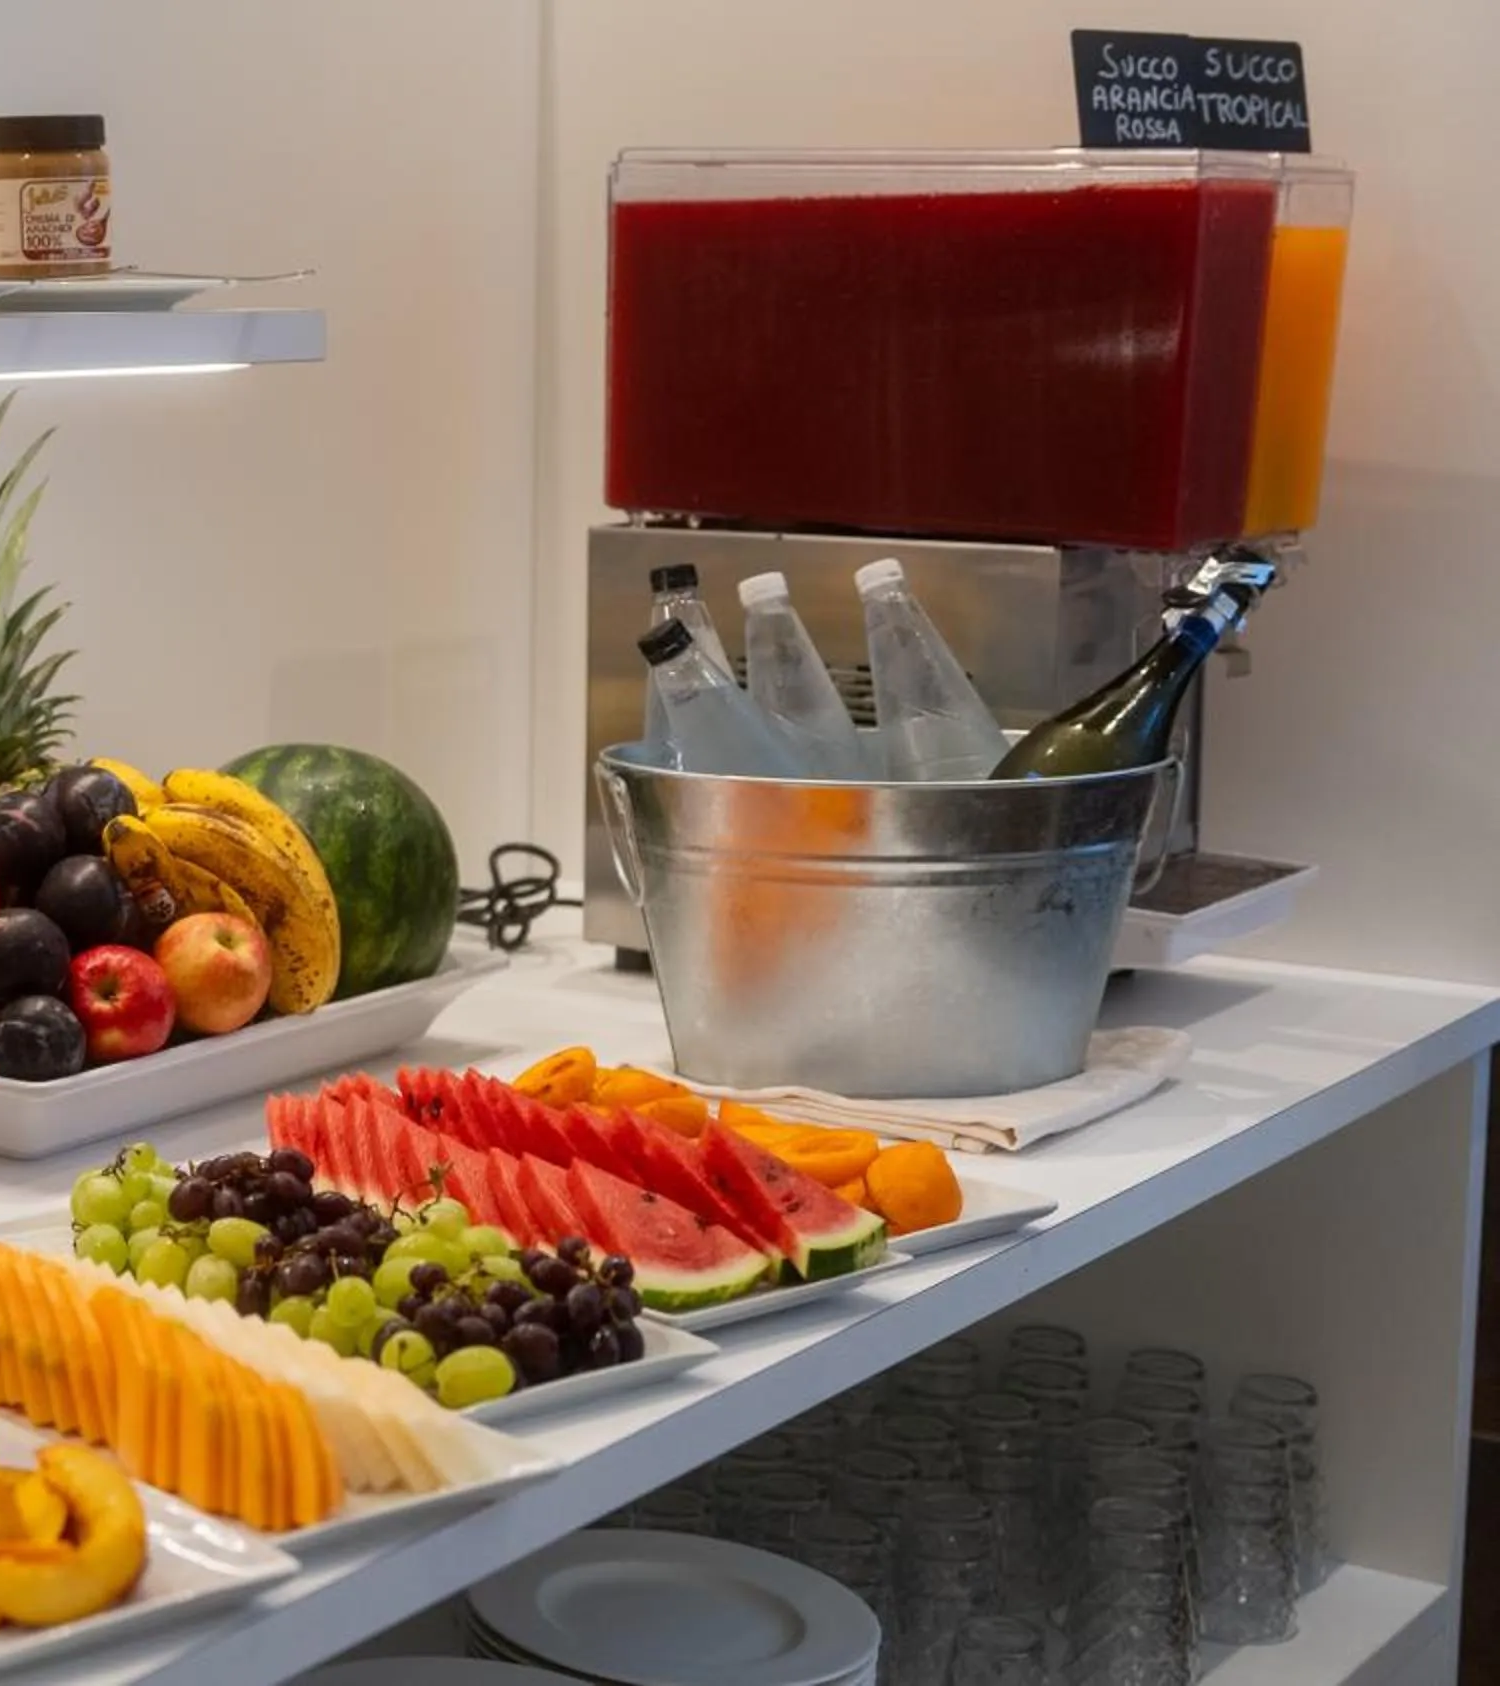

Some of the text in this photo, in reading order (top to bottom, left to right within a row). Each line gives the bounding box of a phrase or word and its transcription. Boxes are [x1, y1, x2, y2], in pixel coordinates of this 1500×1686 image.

[1204, 47, 1297, 84] SUCCO
[1116, 113, 1182, 143] ROSSA
[1197, 93, 1309, 128] TROPICAL
